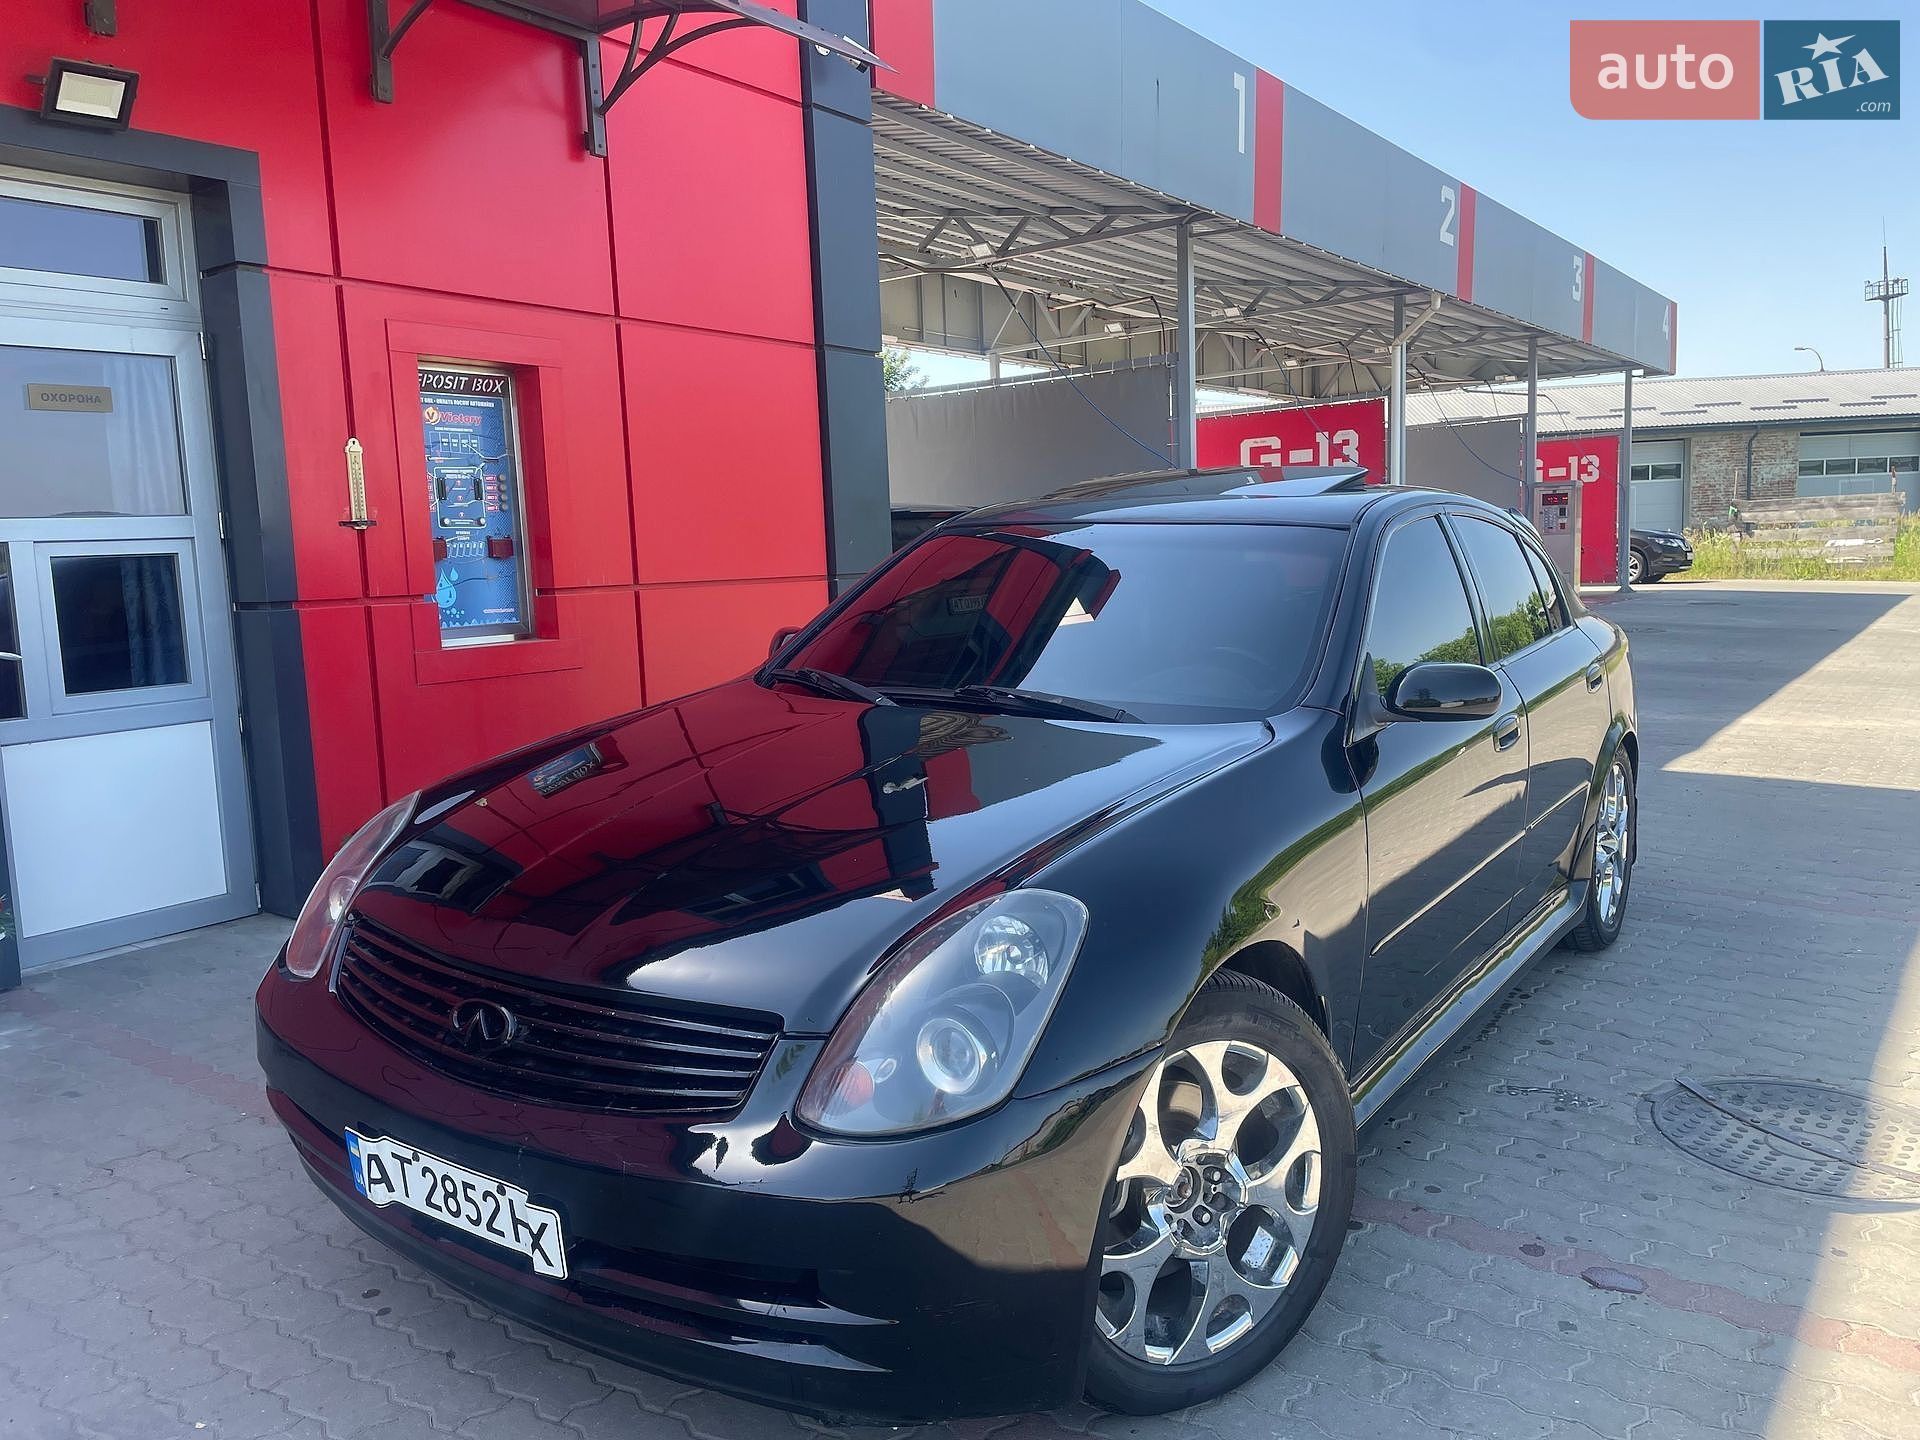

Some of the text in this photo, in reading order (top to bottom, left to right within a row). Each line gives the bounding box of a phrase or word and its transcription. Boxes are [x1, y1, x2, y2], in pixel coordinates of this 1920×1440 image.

[1233, 72, 1246, 154] 1
[1440, 184, 1456, 246] 2
[1572, 255, 1582, 302] 3
[40, 392, 102, 404] ОХОРОНА
[472, 378, 504, 393] BOX
[439, 411, 482, 426] Victory
[1240, 429, 1359, 467] G-13
